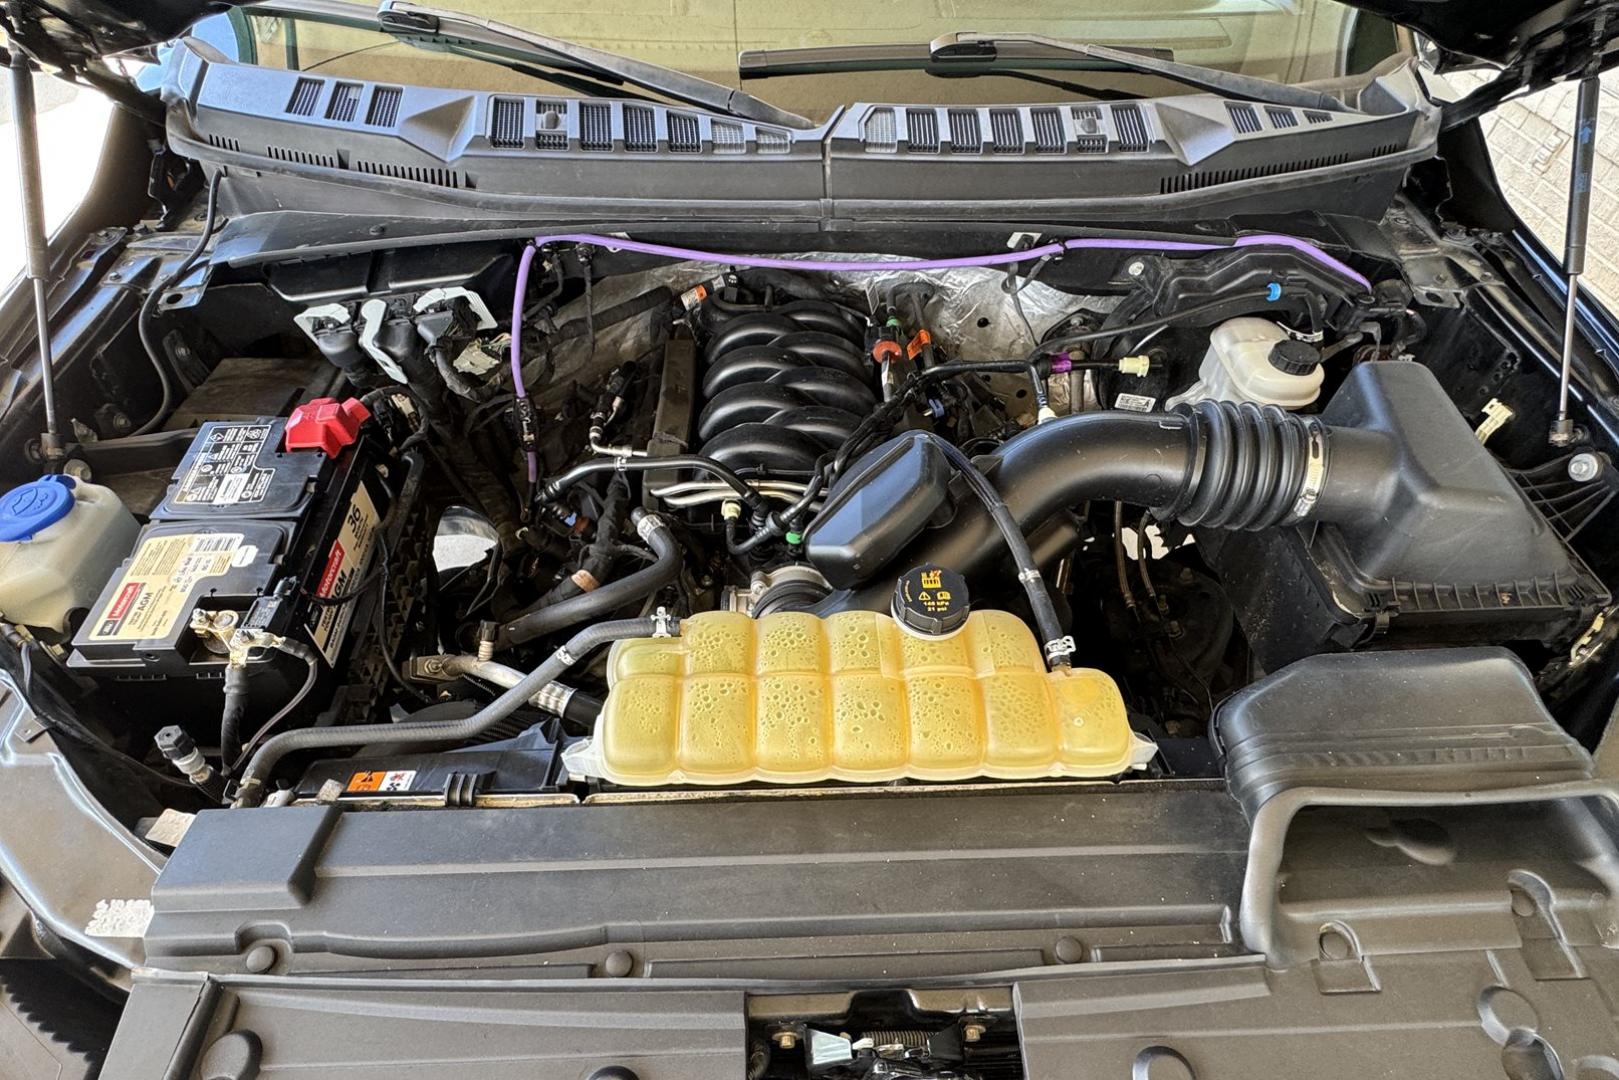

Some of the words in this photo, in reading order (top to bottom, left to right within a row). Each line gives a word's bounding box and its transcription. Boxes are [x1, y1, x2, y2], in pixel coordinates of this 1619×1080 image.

[347, 503, 361, 533] 36
[332, 569, 347, 598] GM
[111, 585, 136, 617] Motorcraft
[137, 592, 153, 611] AGM
